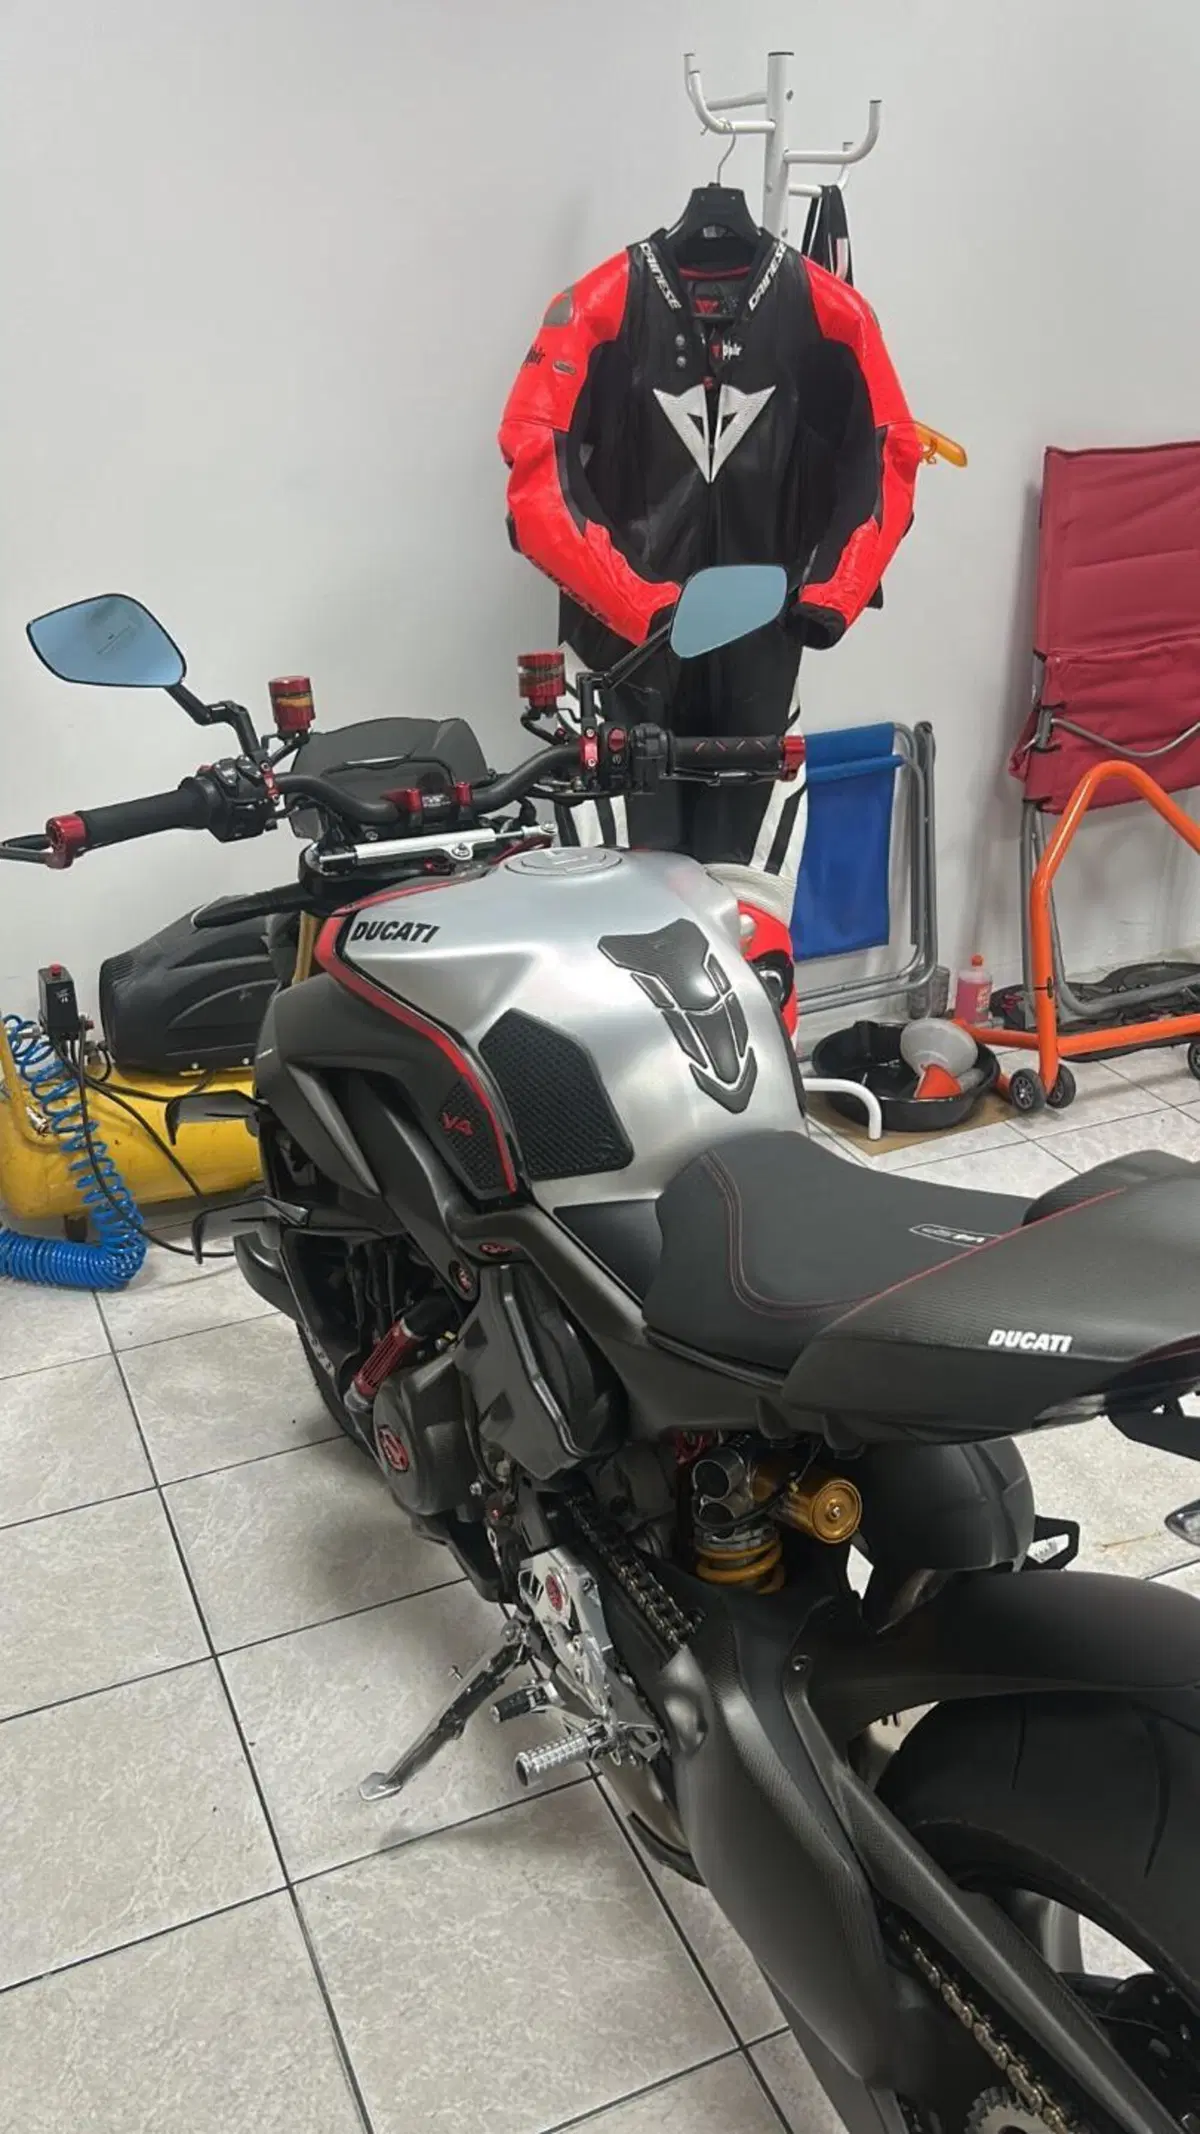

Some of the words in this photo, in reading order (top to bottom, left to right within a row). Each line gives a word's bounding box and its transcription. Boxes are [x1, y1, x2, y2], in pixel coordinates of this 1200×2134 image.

[639, 241, 682, 309] DAINESE
[350, 920, 441, 943] DUCATI
[442, 1111, 475, 1137] V4
[987, 1329, 1073, 1353] DUCATI
